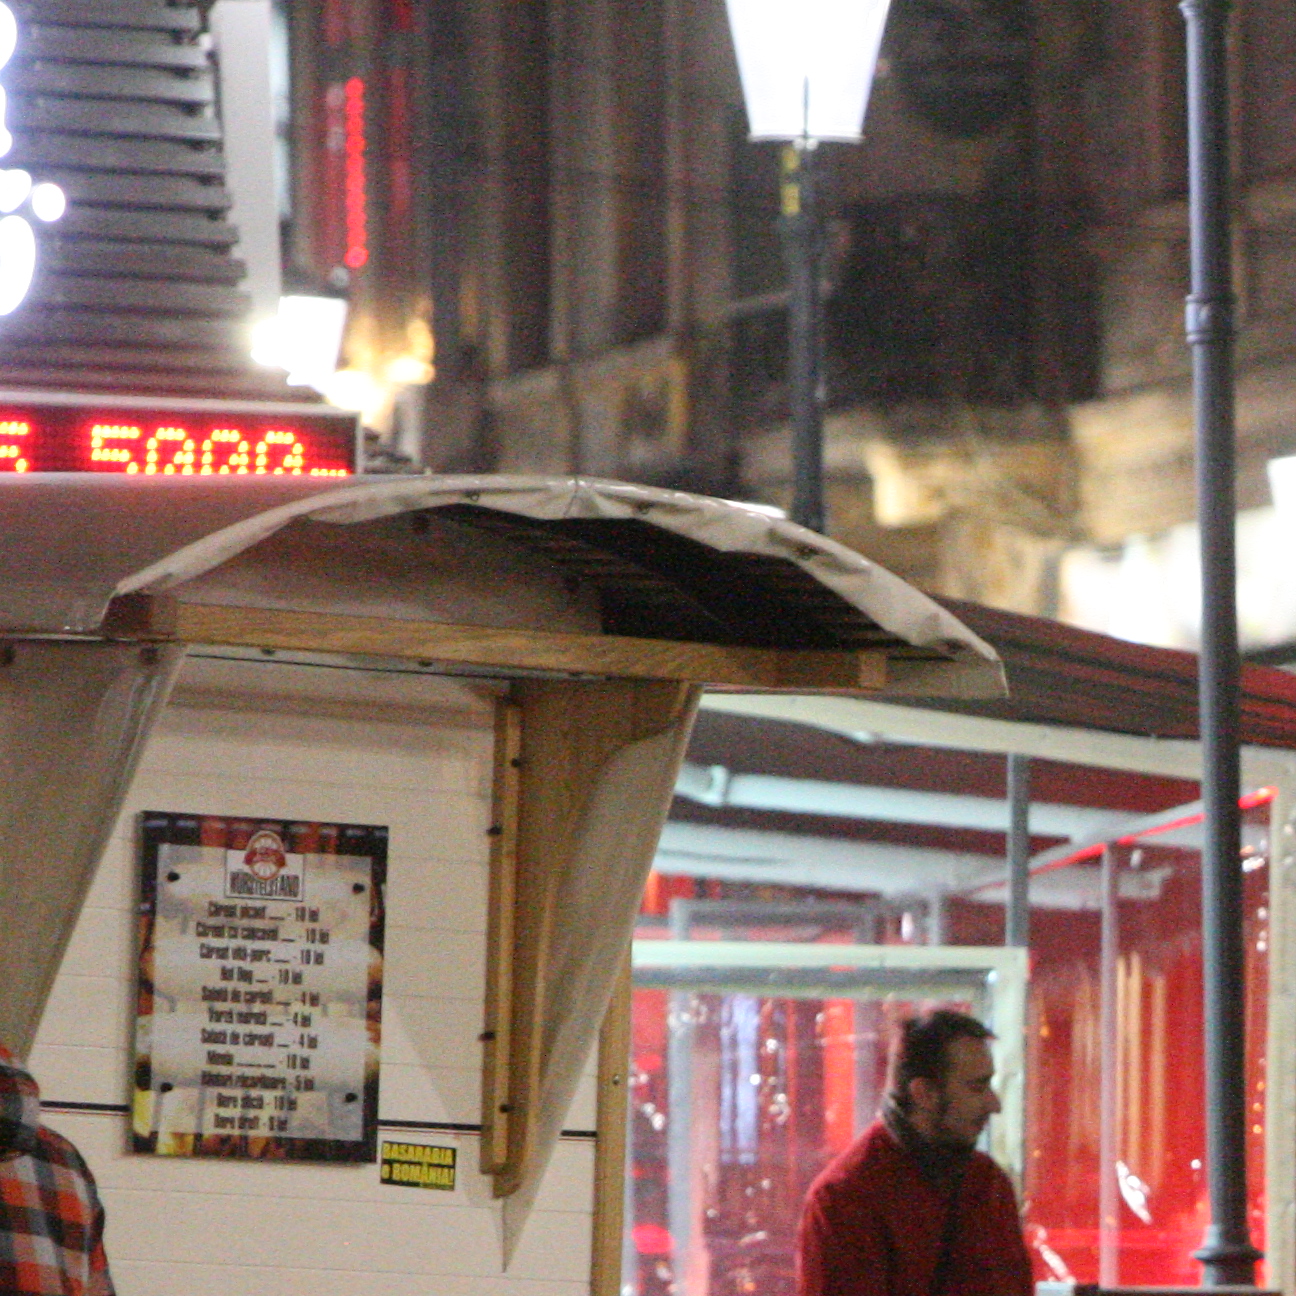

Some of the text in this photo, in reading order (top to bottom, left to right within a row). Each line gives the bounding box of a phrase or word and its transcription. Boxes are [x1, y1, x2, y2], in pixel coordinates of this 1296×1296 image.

[306, 928, 316, 943] 10
[300, 948, 311, 964] 10
[278, 968, 289, 984] 10
[287, 1053, 297, 1069] 10
[382, 1142, 454, 1166] BASARABIA
